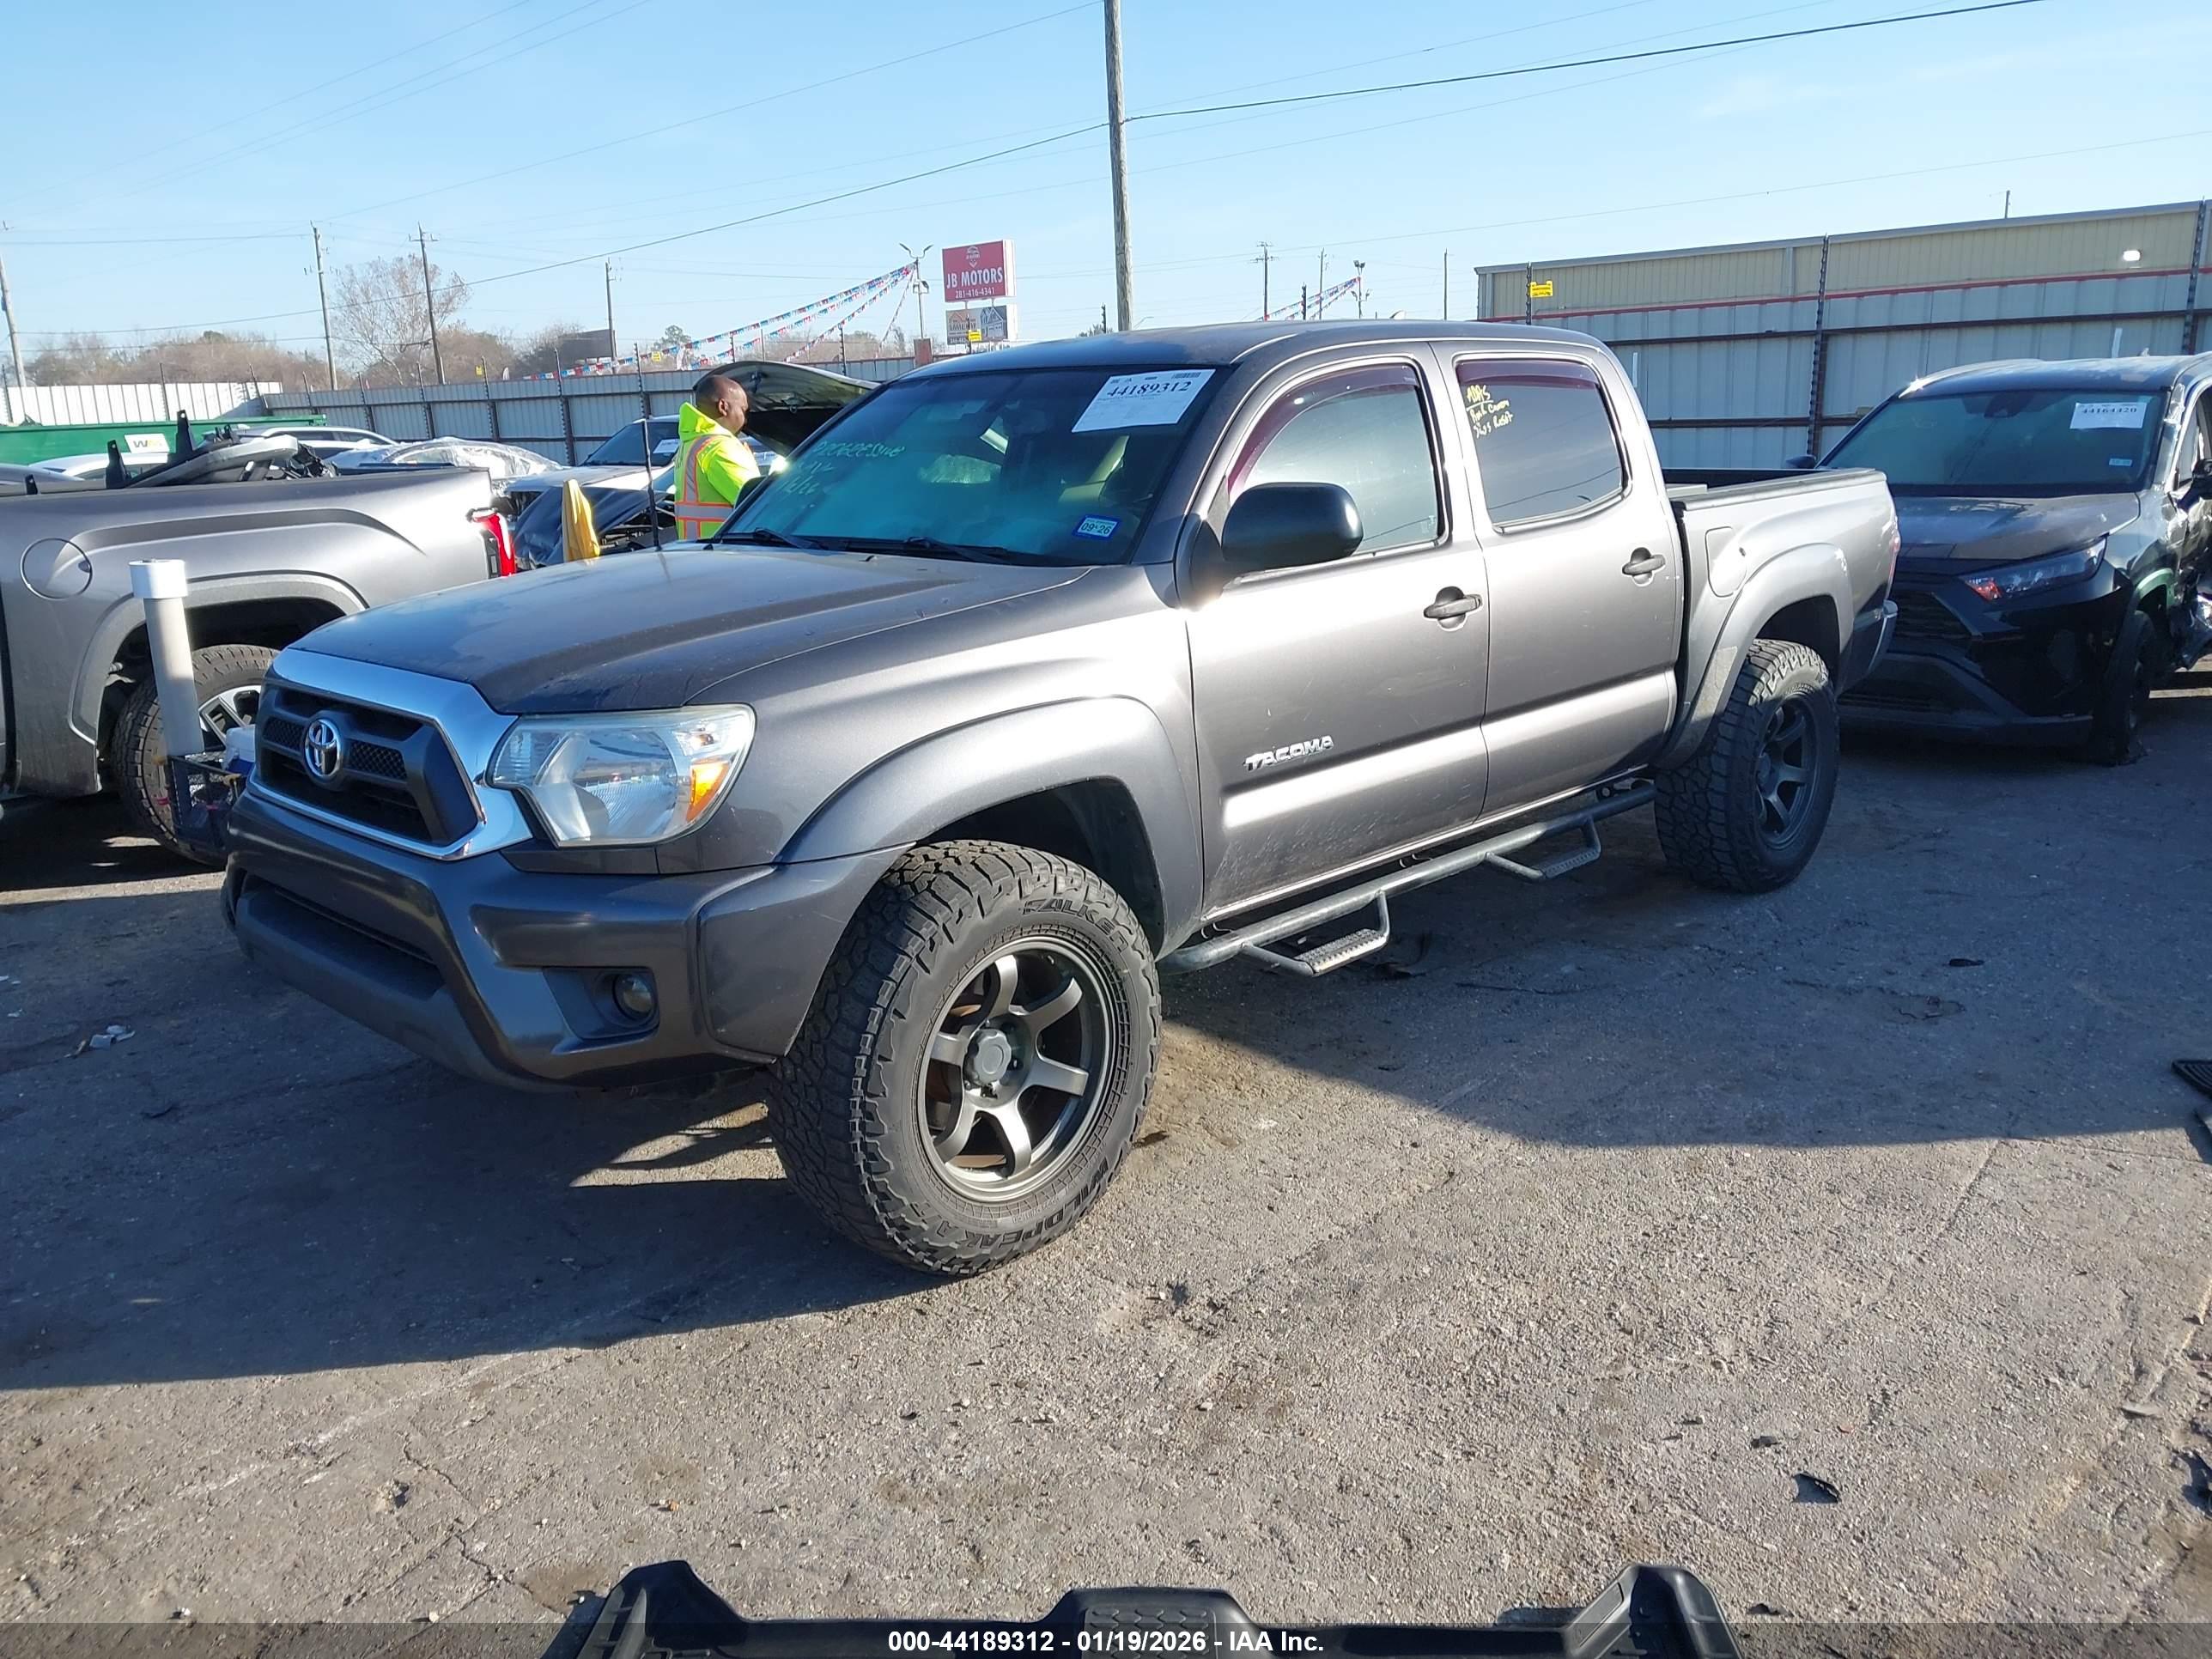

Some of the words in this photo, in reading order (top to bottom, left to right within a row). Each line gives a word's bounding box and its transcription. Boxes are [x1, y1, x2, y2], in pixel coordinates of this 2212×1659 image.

[946, 273, 957, 289] JB
[962, 267, 1003, 287] MOTORS
[955, 288, 995, 298] 281-416-4341
[1106, 380, 1192, 398] 44189312
[1081, 522, 1095, 532] 09
[1097, 525, 1112, 534] 26
[1243, 735, 1334, 771] TACOMA
[1022, 897, 1129, 953] FALKEN
[963, 1156, 1110, 1249] WILDPEAK
